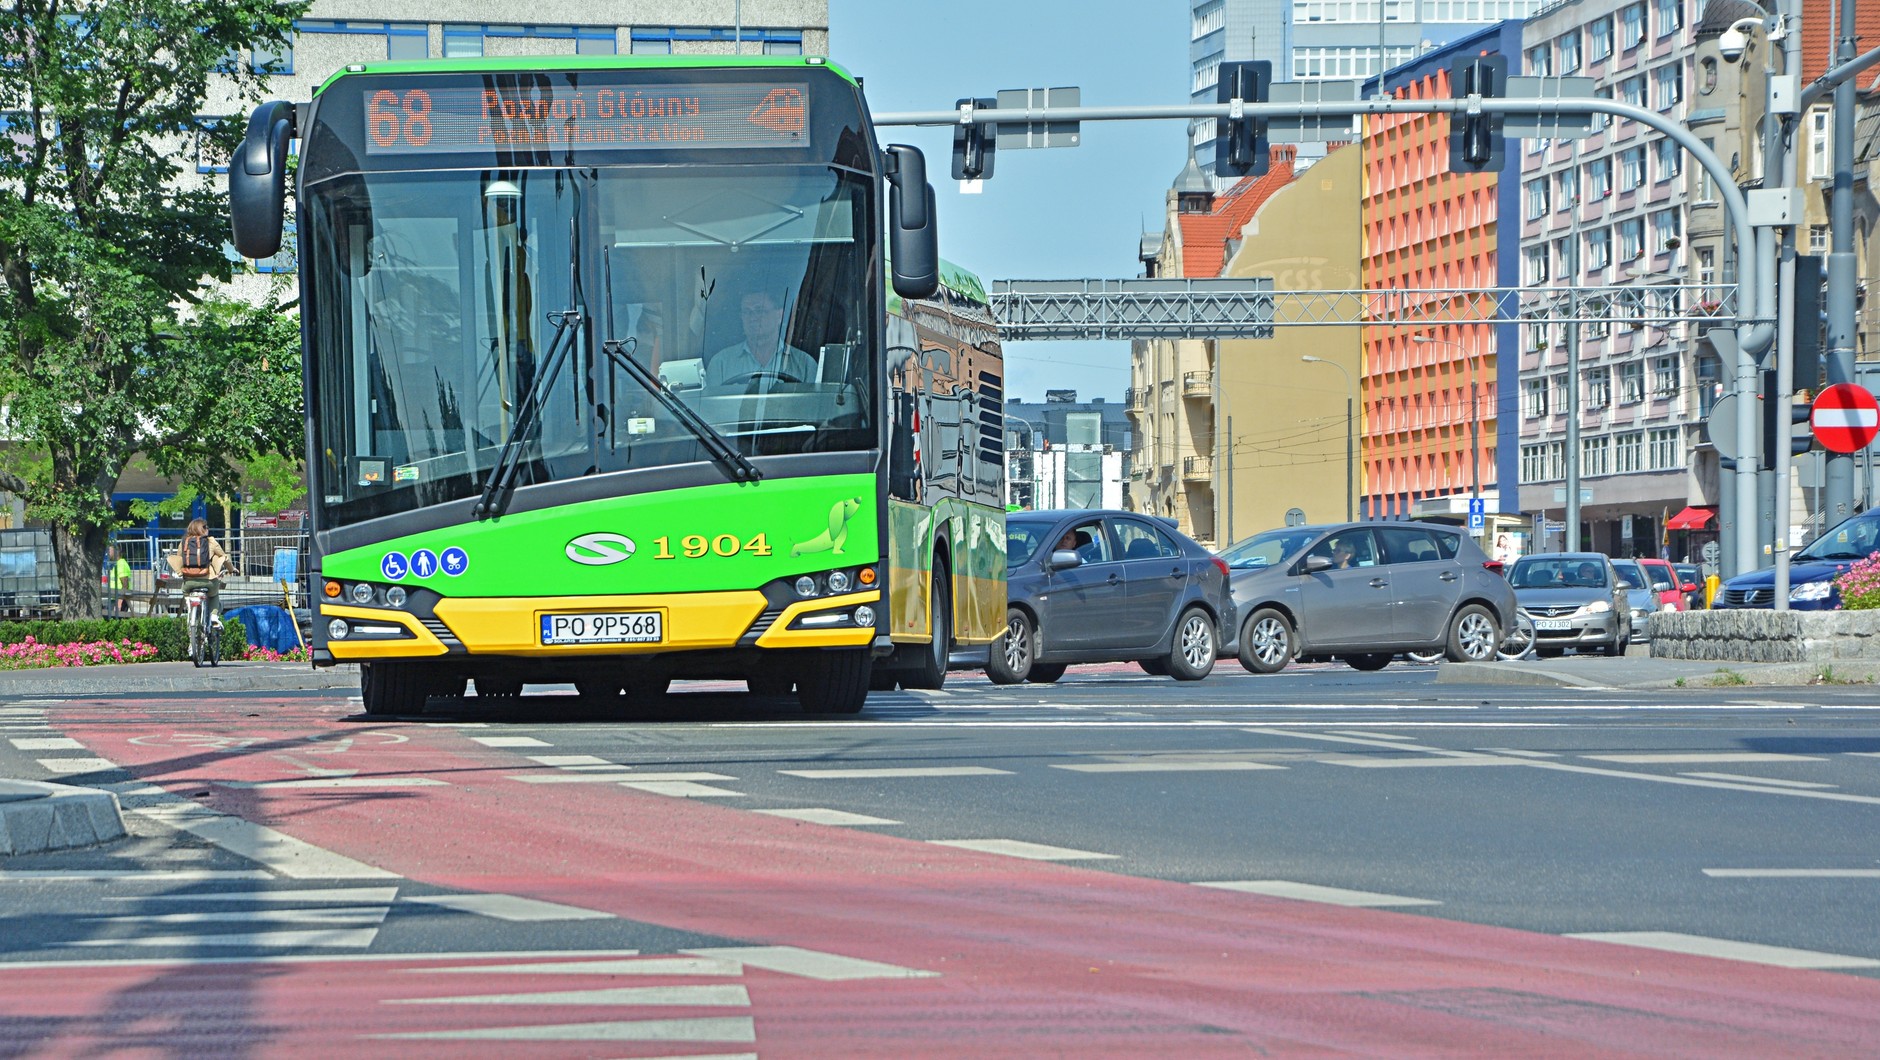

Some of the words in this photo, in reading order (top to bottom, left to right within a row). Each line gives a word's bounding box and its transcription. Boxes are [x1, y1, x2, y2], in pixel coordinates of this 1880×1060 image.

[481, 90, 587, 120] Poznań
[597, 89, 699, 118] Główny
[369, 89, 432, 147] 68
[563, 124, 615, 143] Main
[620, 123, 705, 142] Station
[1472, 514, 1482, 527] P
[653, 532, 772, 560] 1904
[555, 618, 585, 637] PO
[593, 616, 656, 637] 9P568
